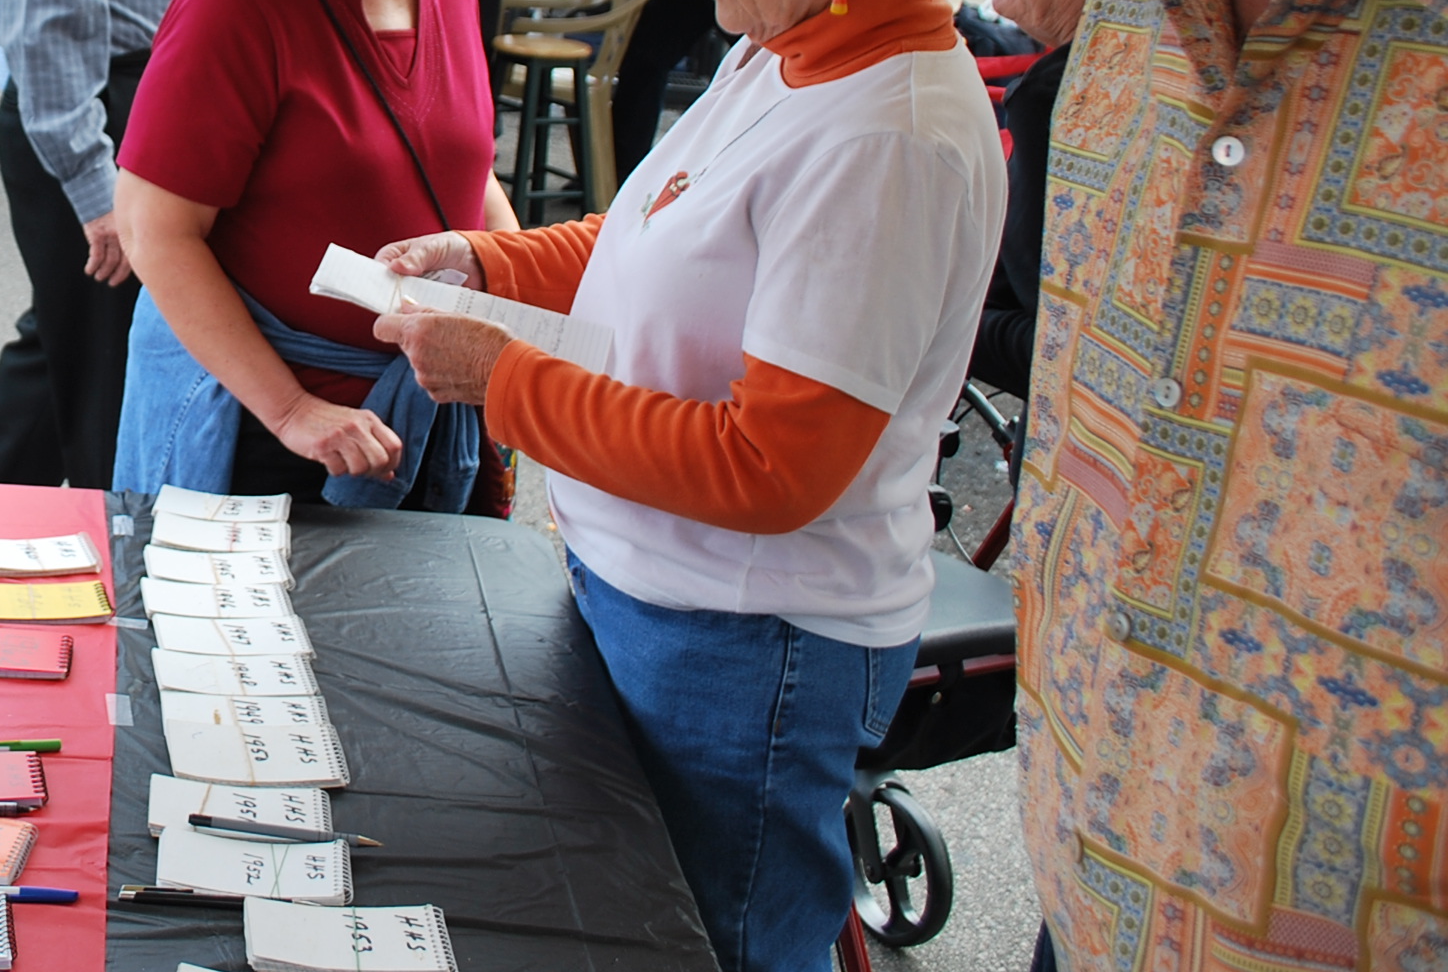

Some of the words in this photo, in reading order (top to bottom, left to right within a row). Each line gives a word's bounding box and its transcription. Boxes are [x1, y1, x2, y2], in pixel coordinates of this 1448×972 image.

[252, 555, 275, 576] HHS
[245, 587, 271, 608] HHS
[222, 623, 252, 646] 1947
[270, 621, 296, 642] HHS
[226, 660, 258, 687] 1948
[269, 660, 297, 685] HHS
[231, 699, 265, 724] 1949
[281, 701, 310, 723] HHS
[242, 733, 269, 762] 1950
[288, 733, 318, 764] HHS
[281, 793, 307, 824] HHS
[241, 853, 265, 886] 1952
[303, 855, 327, 881] HHS
[341, 914, 374, 954] 1953
[394, 914, 427, 952] HHS
